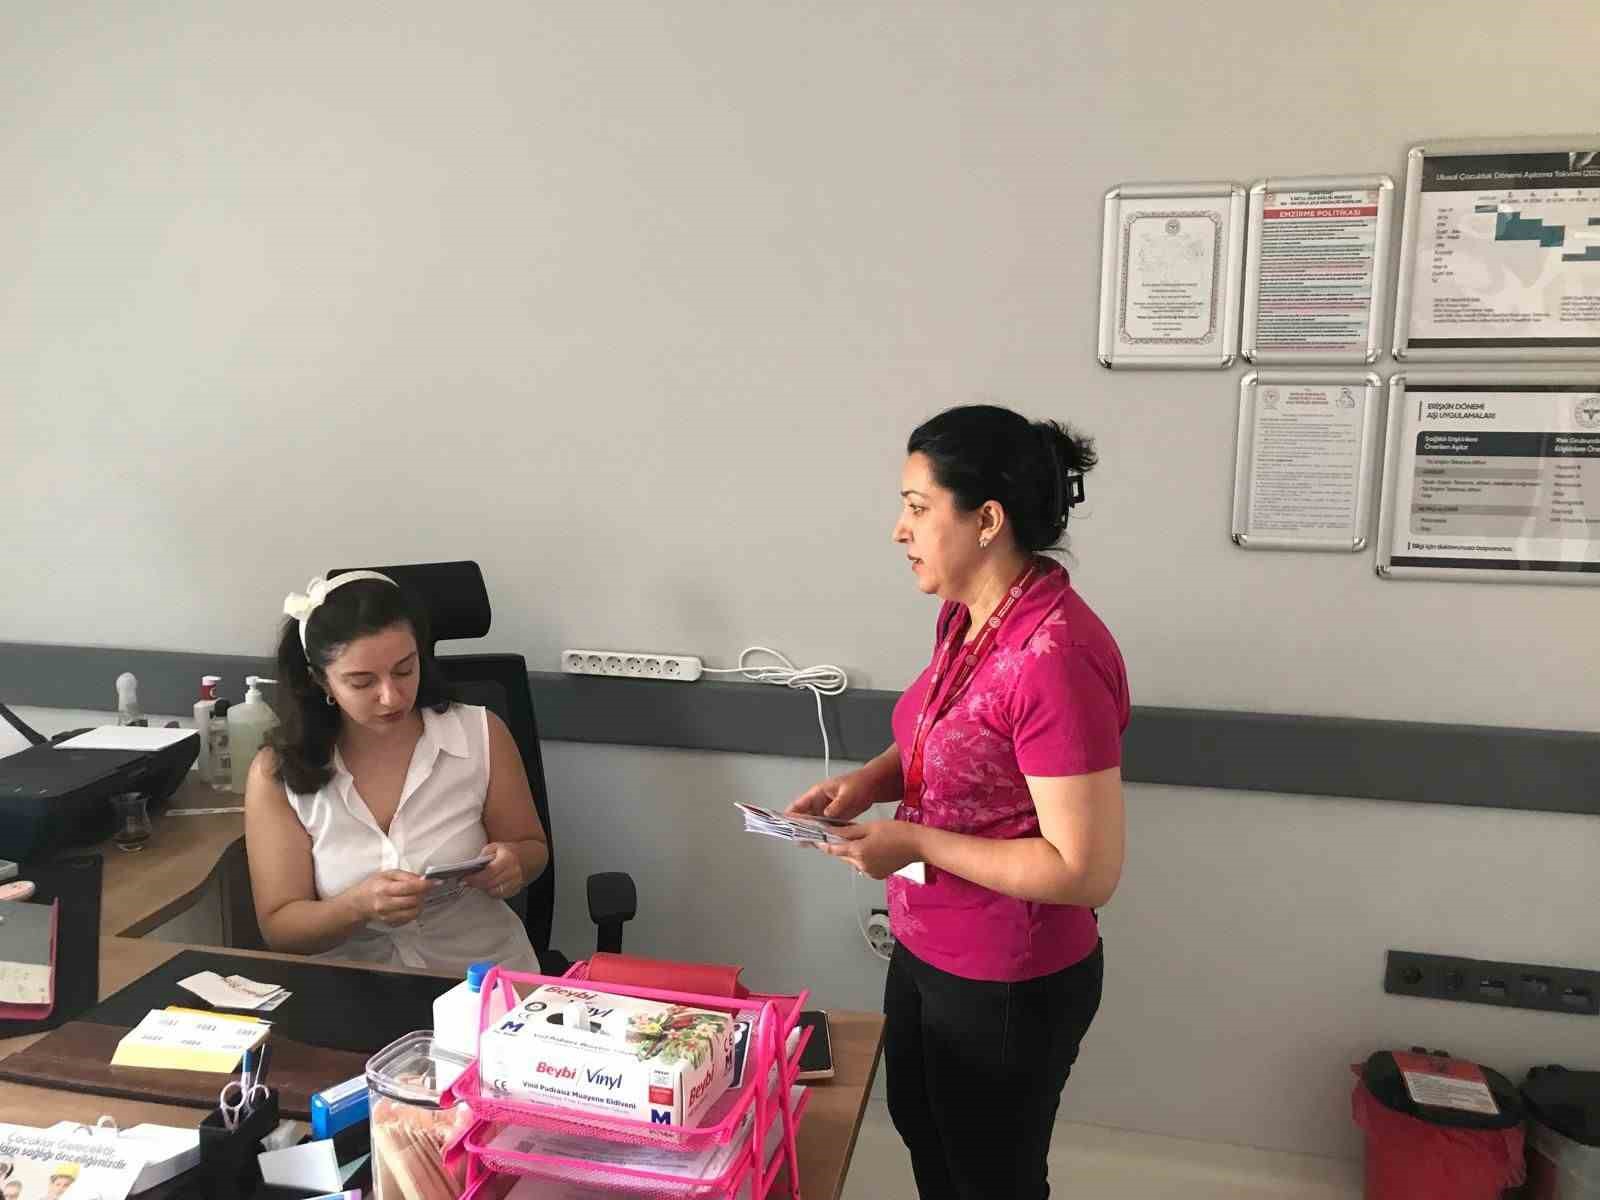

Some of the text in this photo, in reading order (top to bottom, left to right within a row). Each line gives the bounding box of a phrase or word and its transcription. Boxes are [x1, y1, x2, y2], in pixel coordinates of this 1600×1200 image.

[544, 986, 598, 1001] Beybi
[501, 1020, 525, 1033] M
[536, 1061, 623, 1091] Beybi Vinyl
[688, 1063, 715, 1108] Beybi
[572, 1091, 605, 1104] Muayene
[651, 1109, 671, 1125] M
